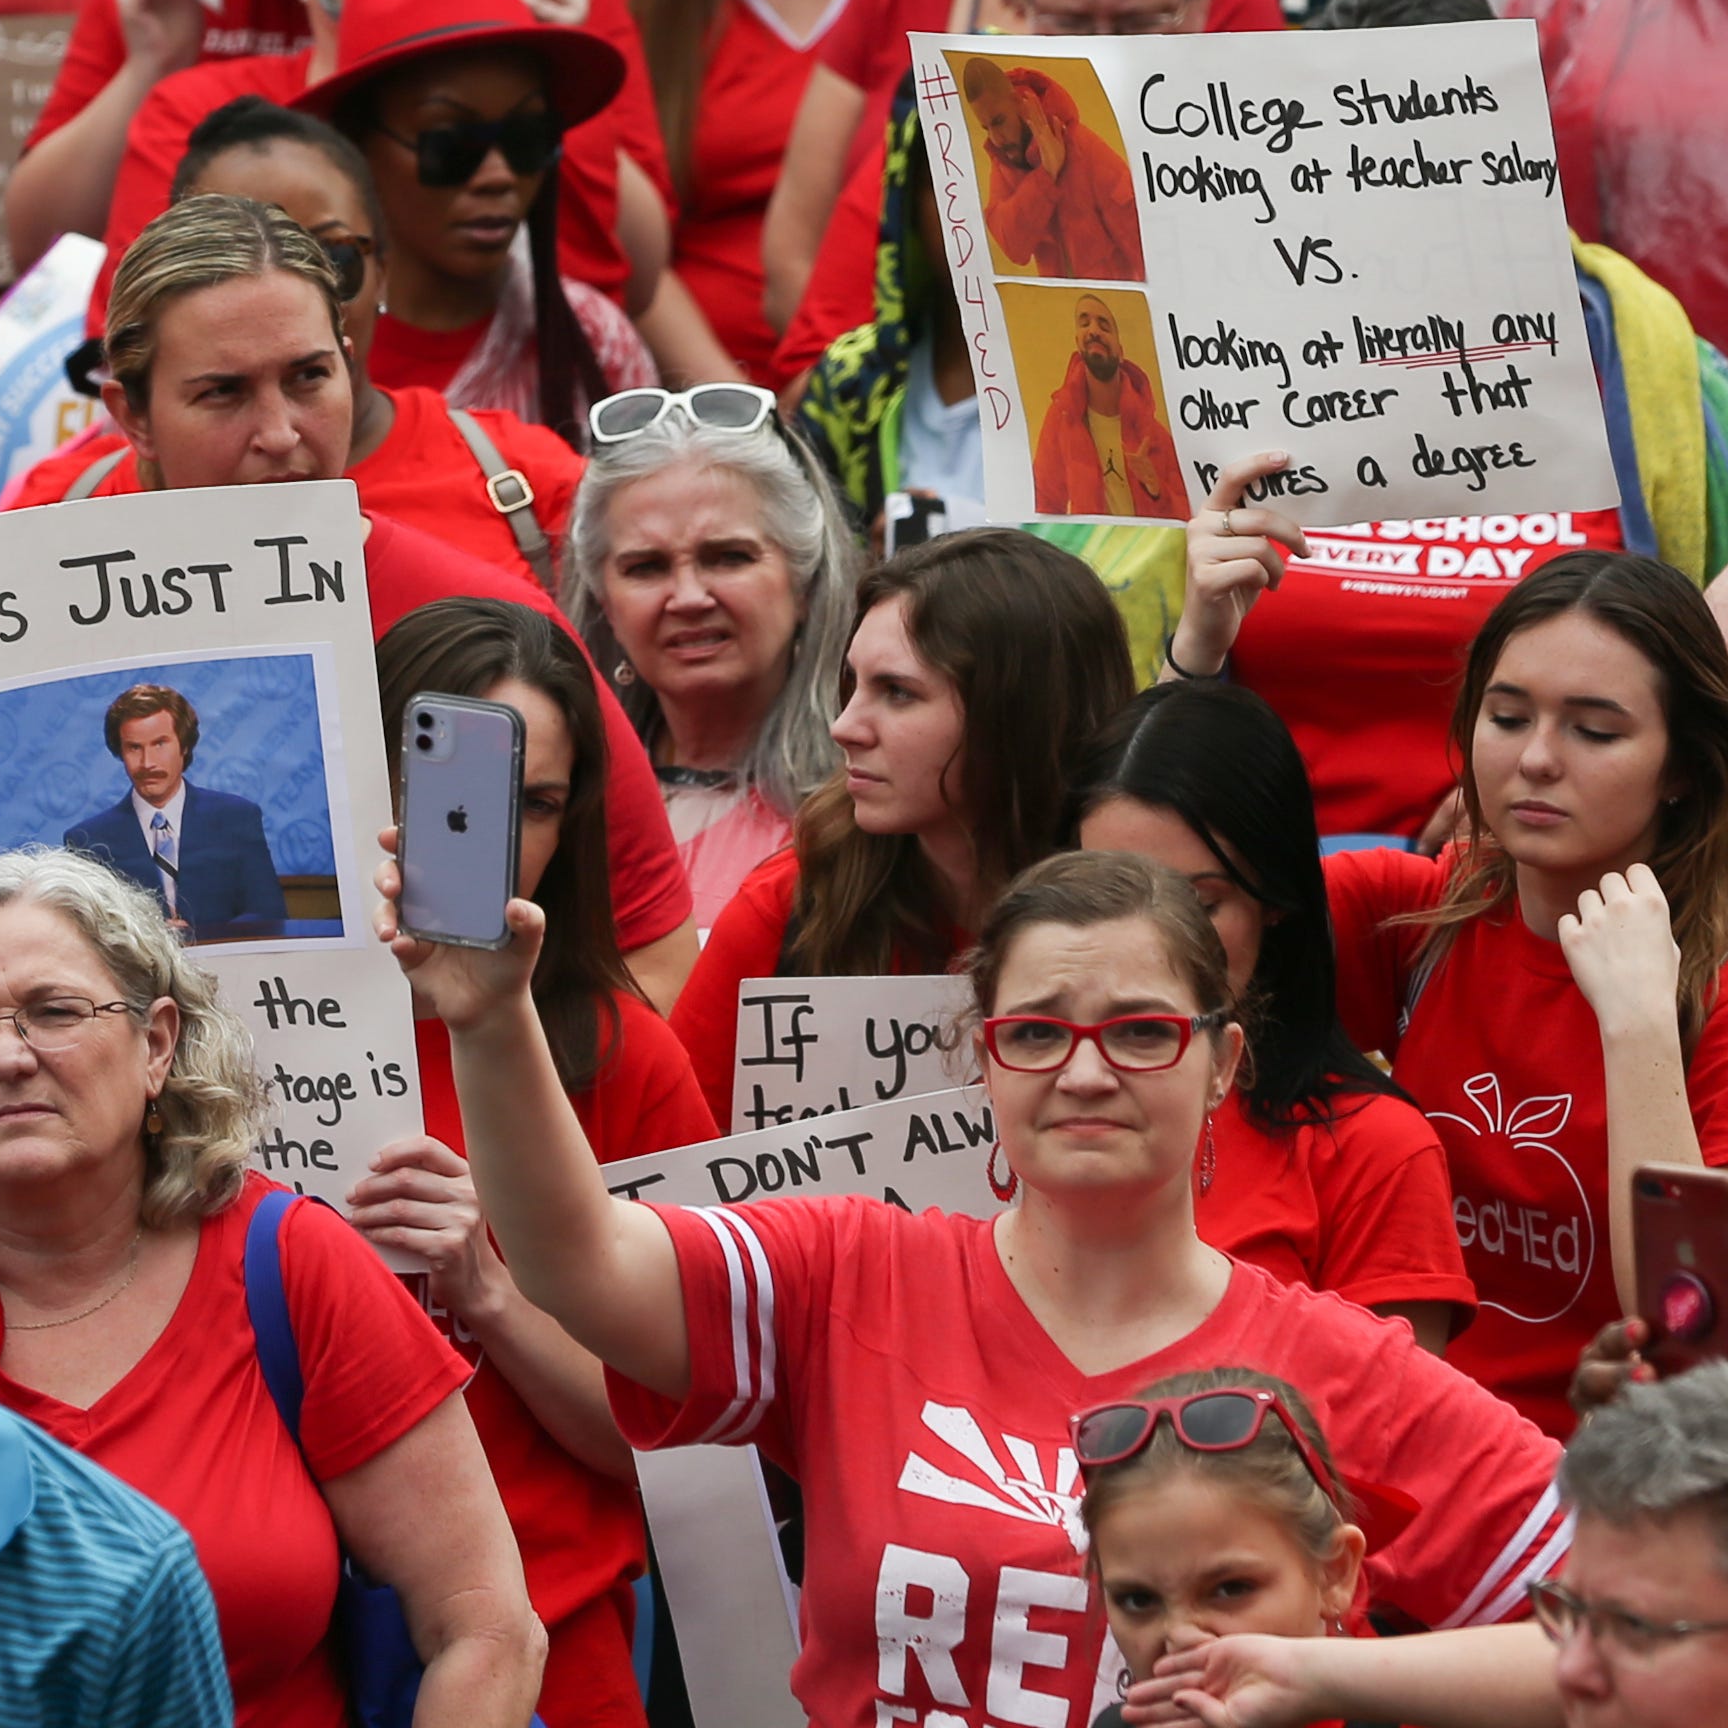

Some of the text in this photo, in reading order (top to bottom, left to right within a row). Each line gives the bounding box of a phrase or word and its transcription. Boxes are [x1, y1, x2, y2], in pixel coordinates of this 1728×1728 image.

[1139, 72, 1323, 153] College
[1143, 151, 1278, 224] looking
[1290, 161, 1333, 195] at
[1346, 139, 1466, 192] teacher
[1168, 310, 1560, 388] looking at literally any
[1442, 362, 1532, 420] that
[1357, 453, 1388, 489] a
[1413, 432, 1537, 492] degree
[1377, 511, 1587, 545] SCHOOL
[1310, 543, 1535, 579] EVERY DAY
[254, 978, 349, 1033] the
[369, 1052, 409, 1099] is
[741, 993, 964, 1102] If you
[255, 1120, 340, 1174] the
[705, 1131, 874, 1206] DON'T
[875, 1542, 1092, 1728] RE
